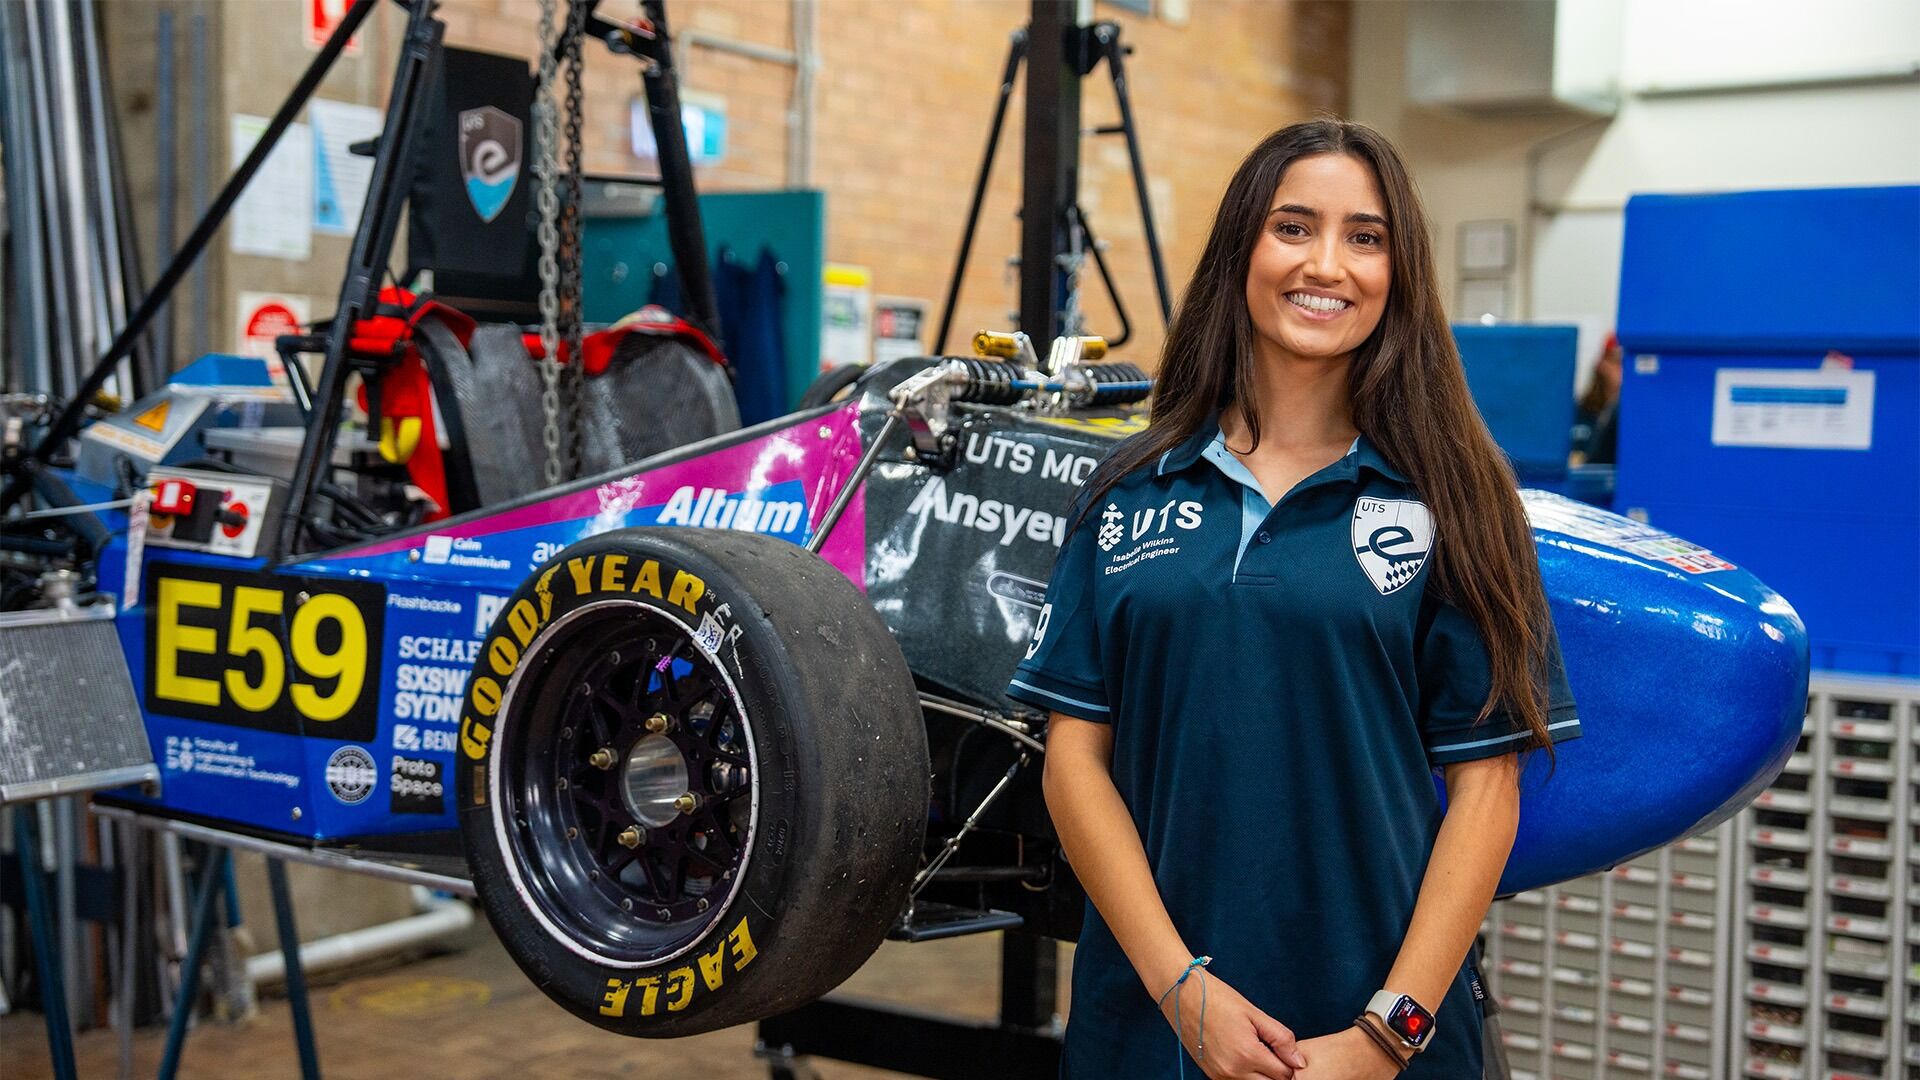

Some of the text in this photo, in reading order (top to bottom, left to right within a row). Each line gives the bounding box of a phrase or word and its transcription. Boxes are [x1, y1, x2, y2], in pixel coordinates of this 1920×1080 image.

[964, 432, 1036, 475] UTS
[656, 485, 804, 534] Altium
[1131, 499, 1203, 541] UTS
[1361, 501, 1386, 513] UTS
[1104, 547, 1180, 575] Electrical Engineer
[1142, 537, 1174, 550] Wilkins
[155, 577, 368, 722] E59
[391, 755, 436, 777] Proto
[390, 773, 443, 797] Space
[599, 916, 759, 1018] EAGLE
